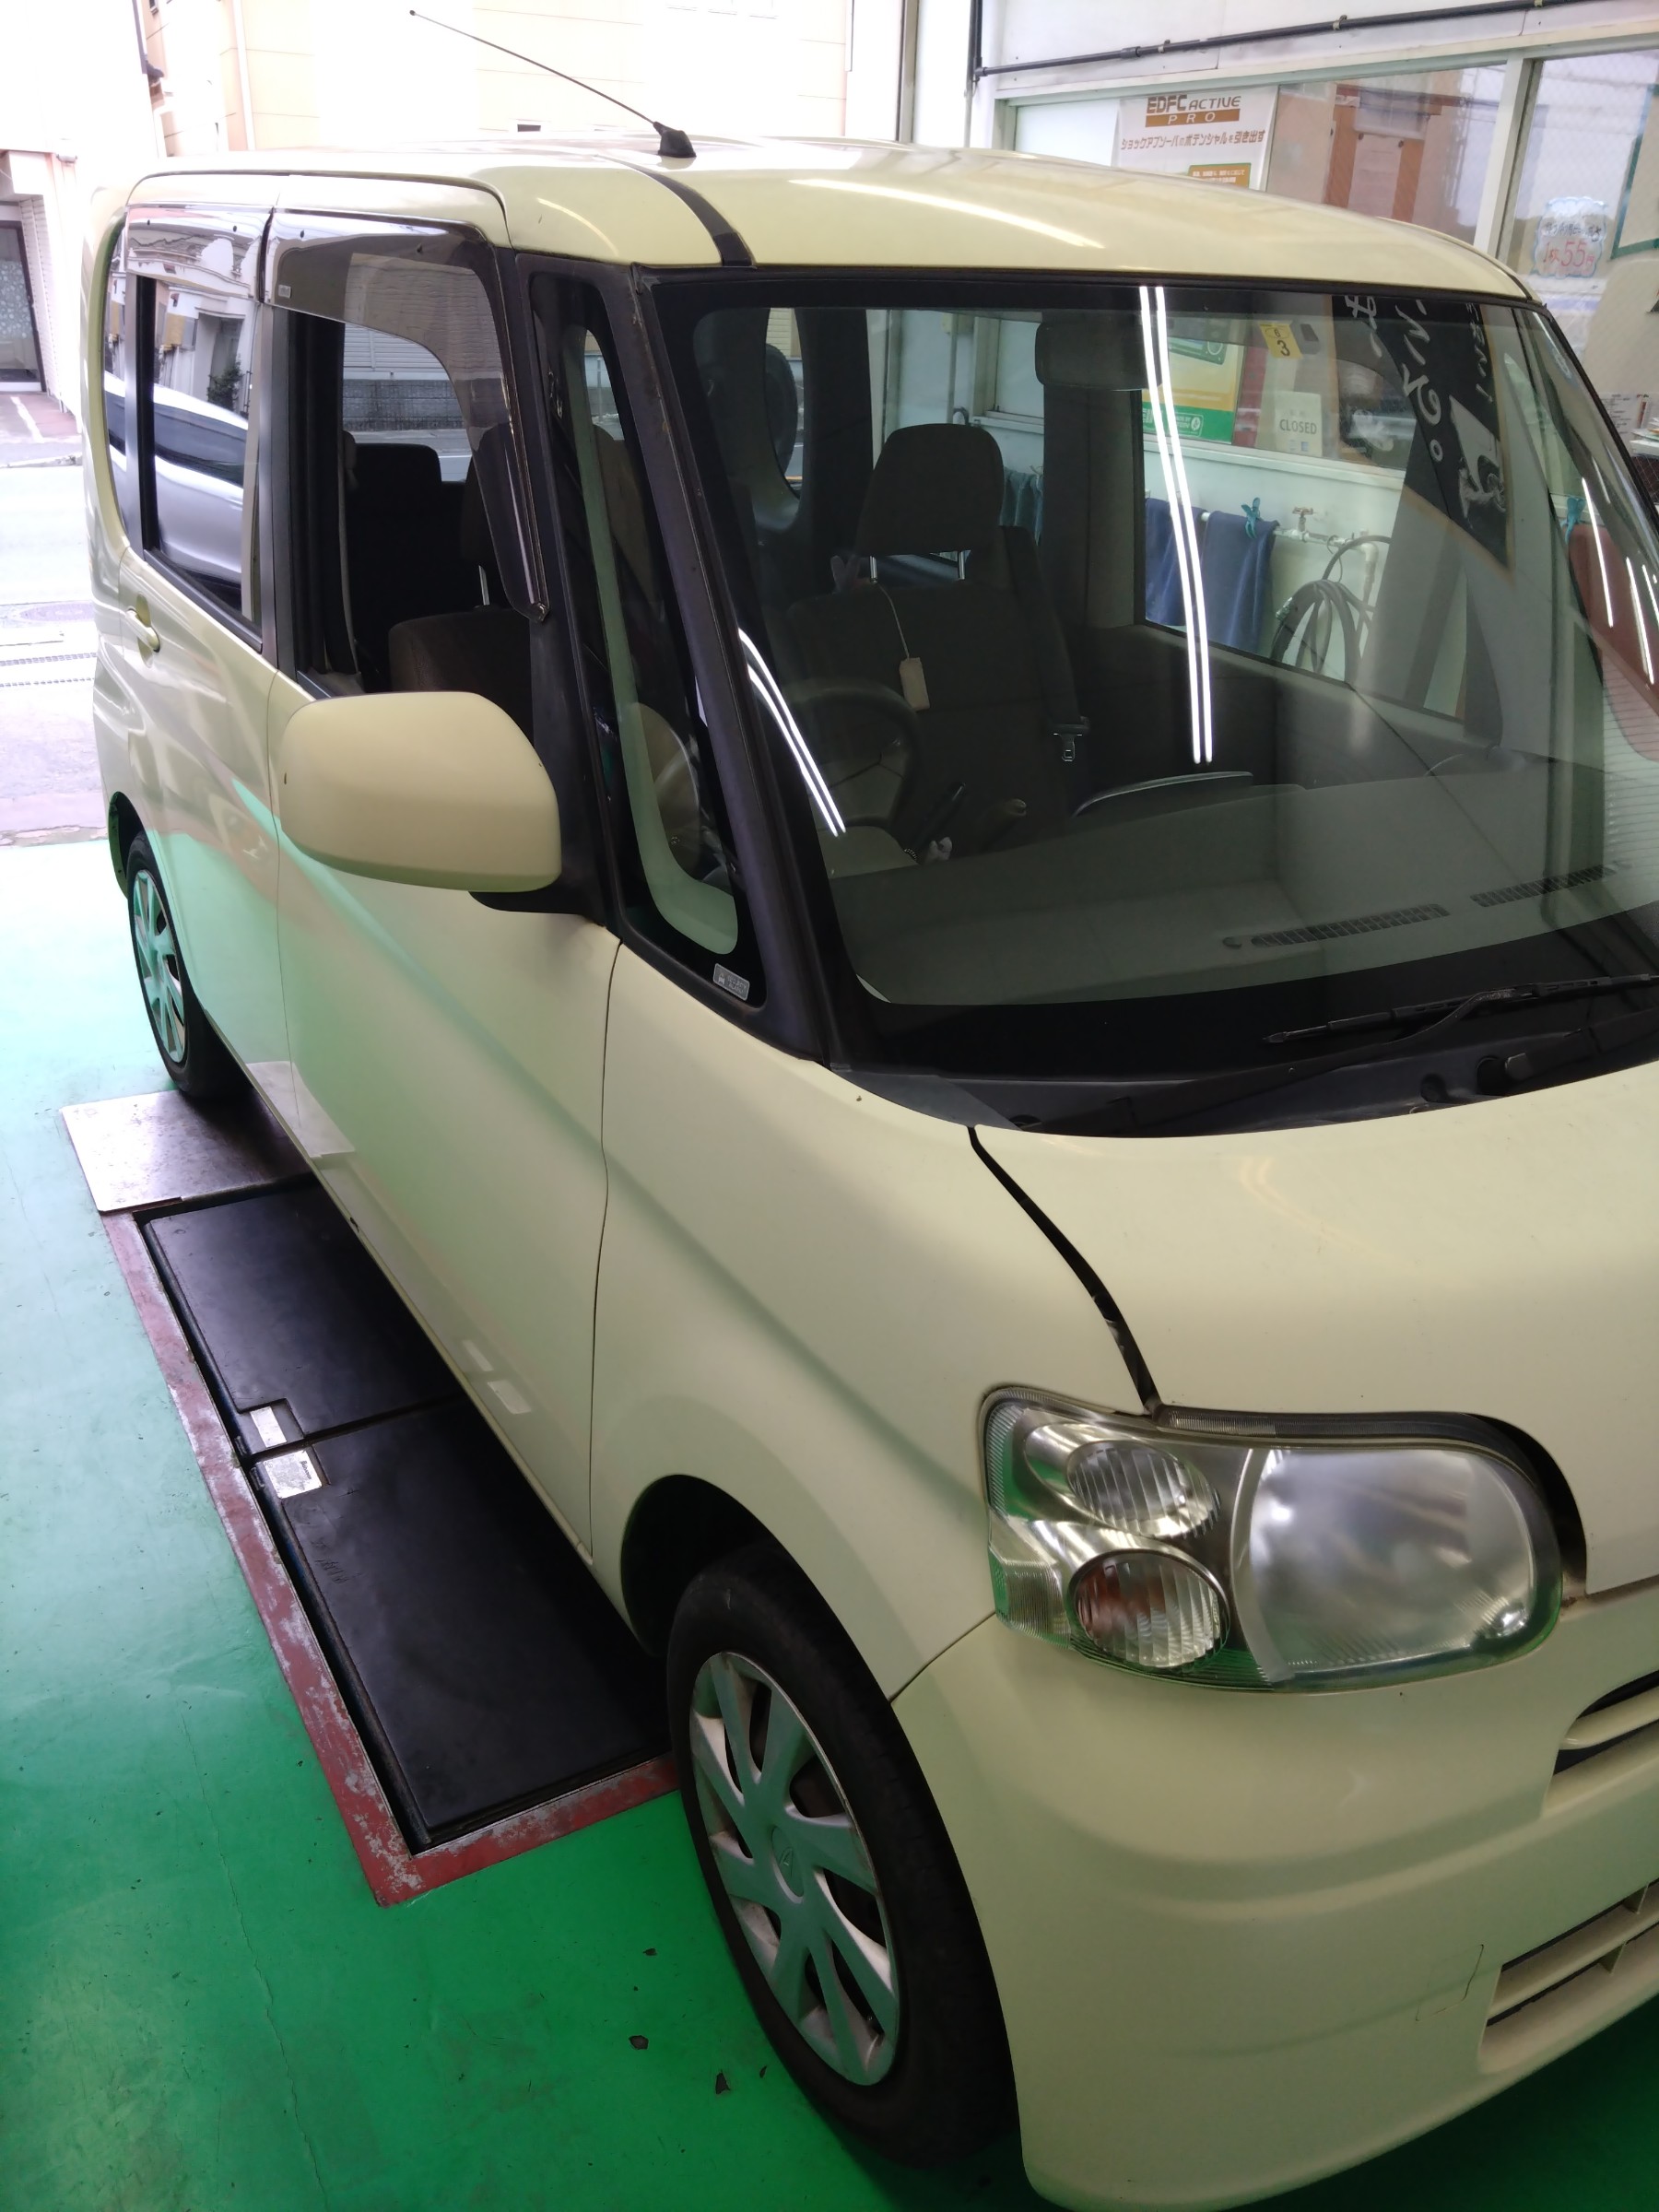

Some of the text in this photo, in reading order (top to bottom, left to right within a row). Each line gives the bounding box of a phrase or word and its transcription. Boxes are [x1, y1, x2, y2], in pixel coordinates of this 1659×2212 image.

[1147, 94, 1241, 113] EDFC ACTIVE
[1167, 112, 1216, 125] PRO
[1277, 339, 1290, 357] 3
[1279, 418, 1318, 435] CLOSED
